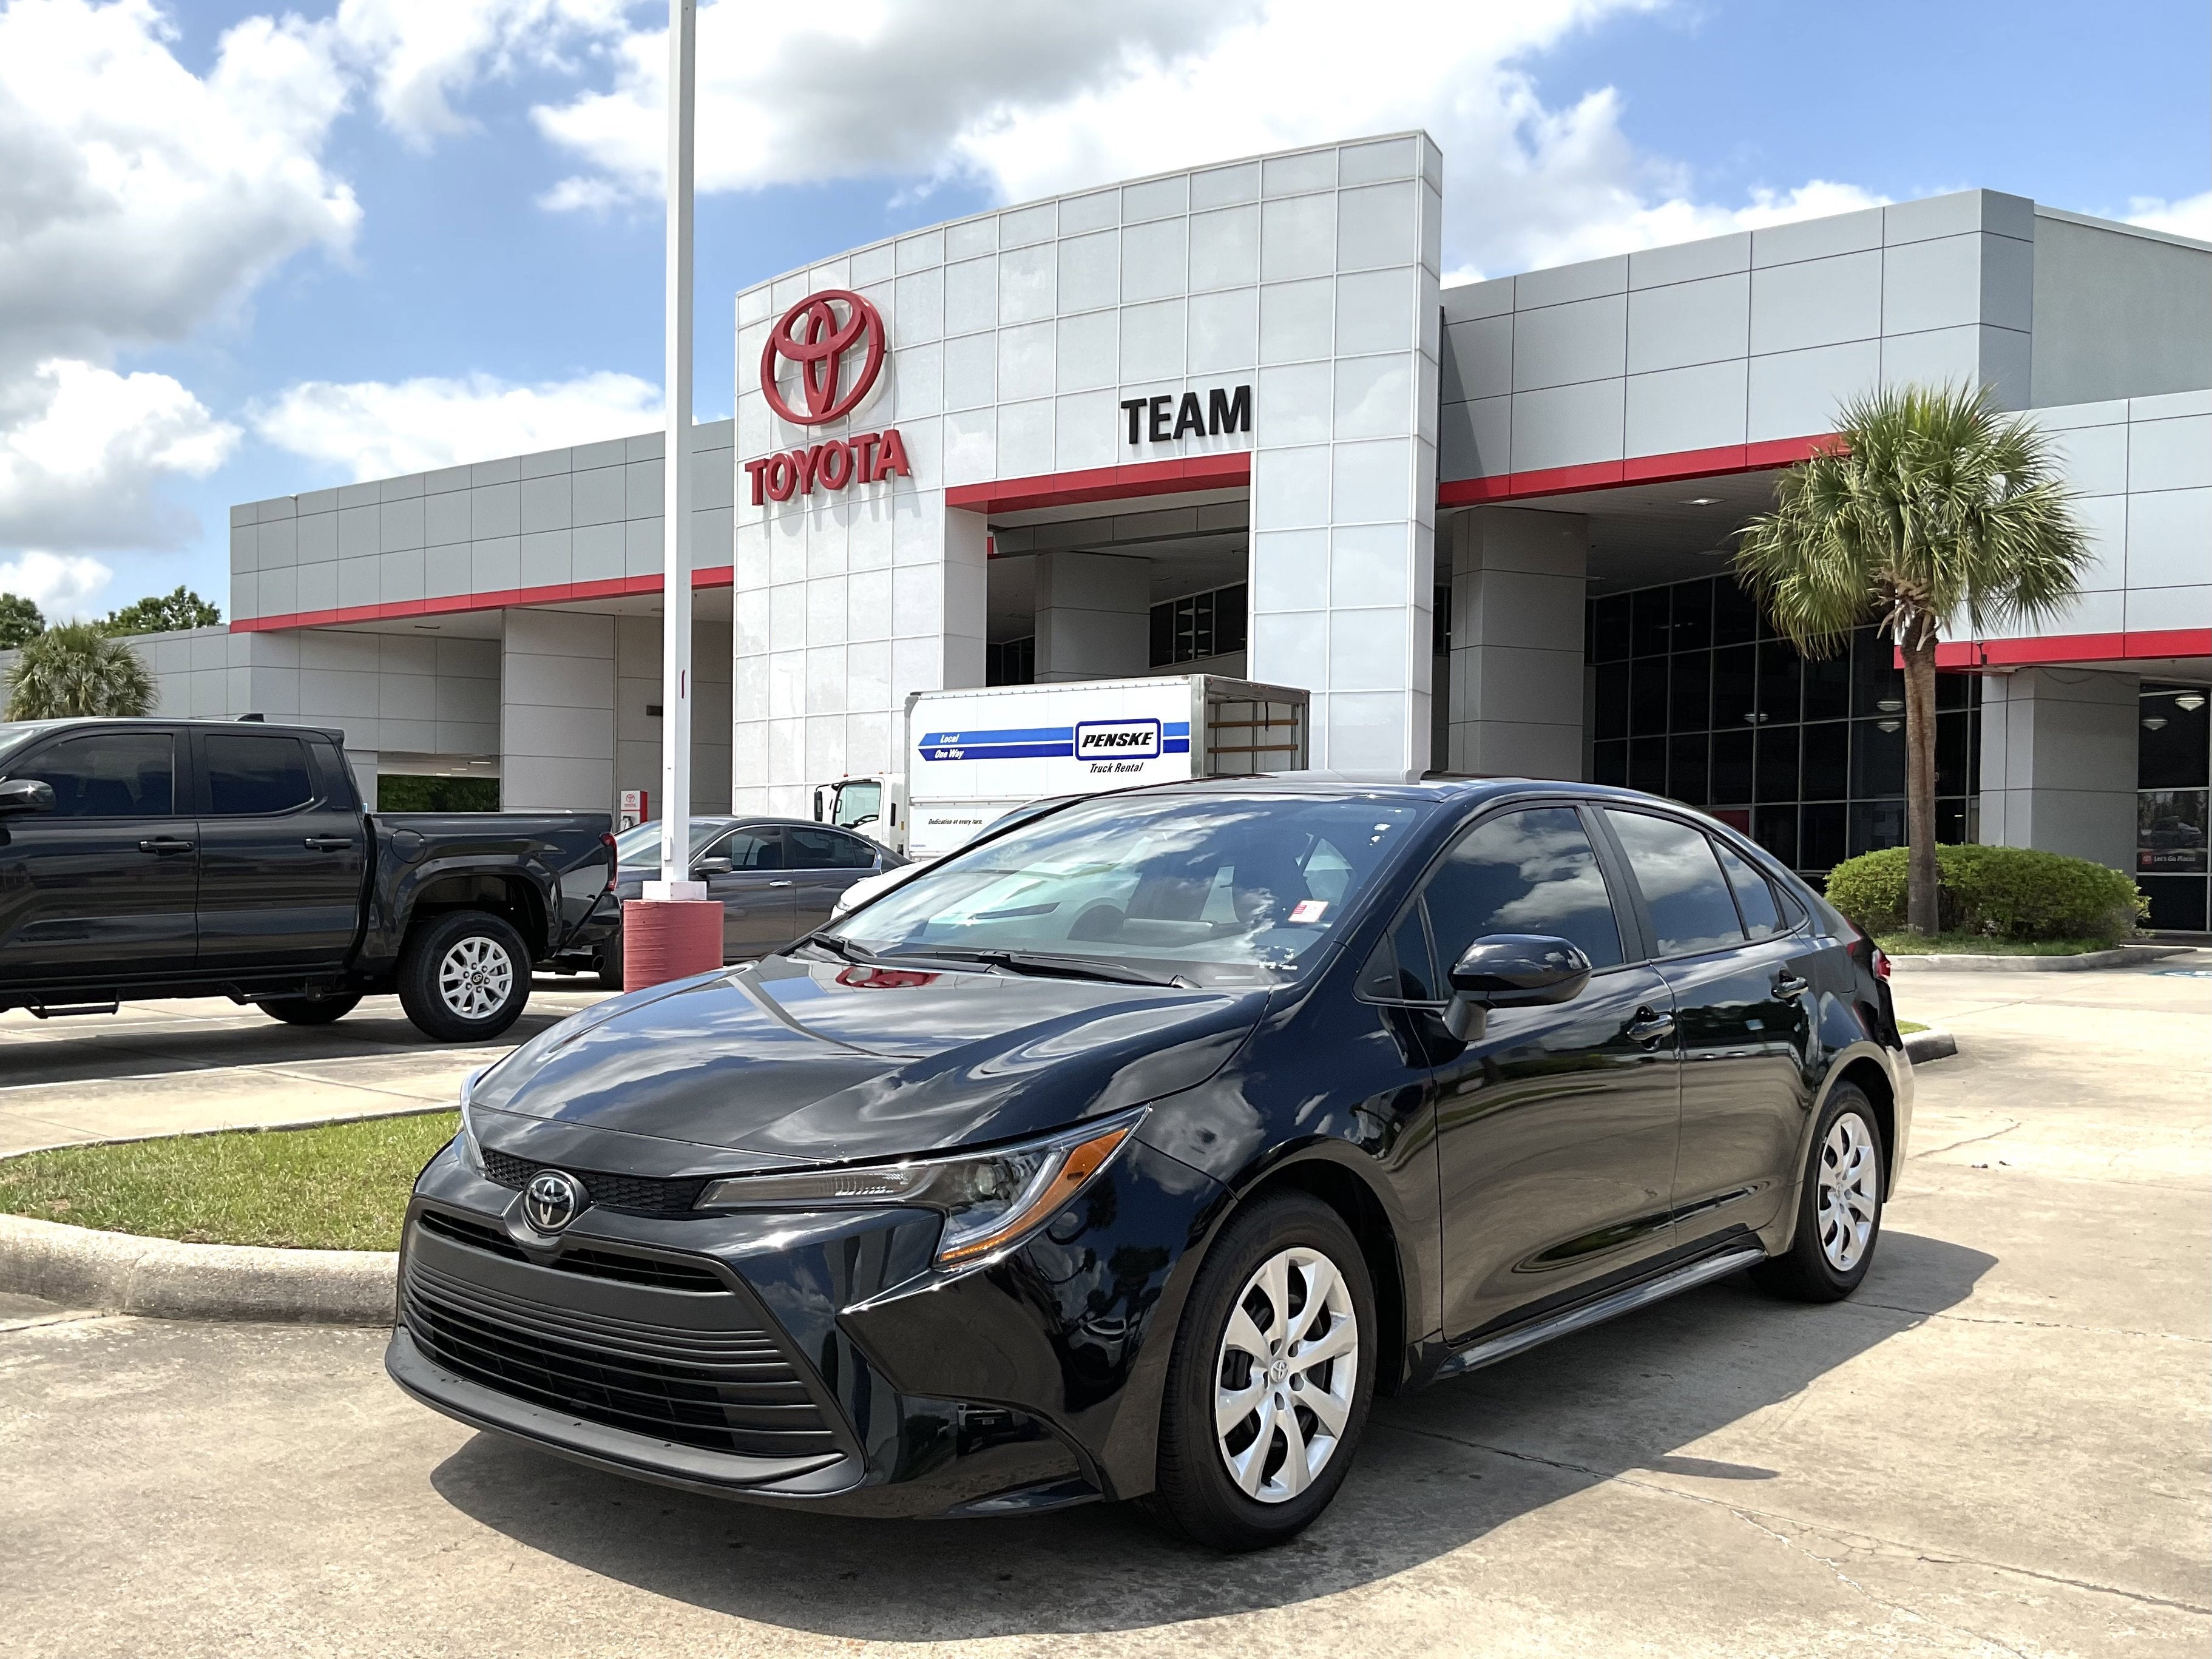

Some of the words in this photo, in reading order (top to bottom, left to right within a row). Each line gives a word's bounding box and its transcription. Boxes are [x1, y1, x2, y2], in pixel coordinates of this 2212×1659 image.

[1120, 385, 1250, 444] TEAM
[745, 429, 911, 506] TOYOTA
[939, 734, 960, 743] Local
[1081, 732, 1154, 748] PENSKE
[935, 749, 949, 759] One
[949, 749, 964, 760] Way
[1090, 763, 1114, 773] Truck
[1114, 762, 1145, 772] Rental
